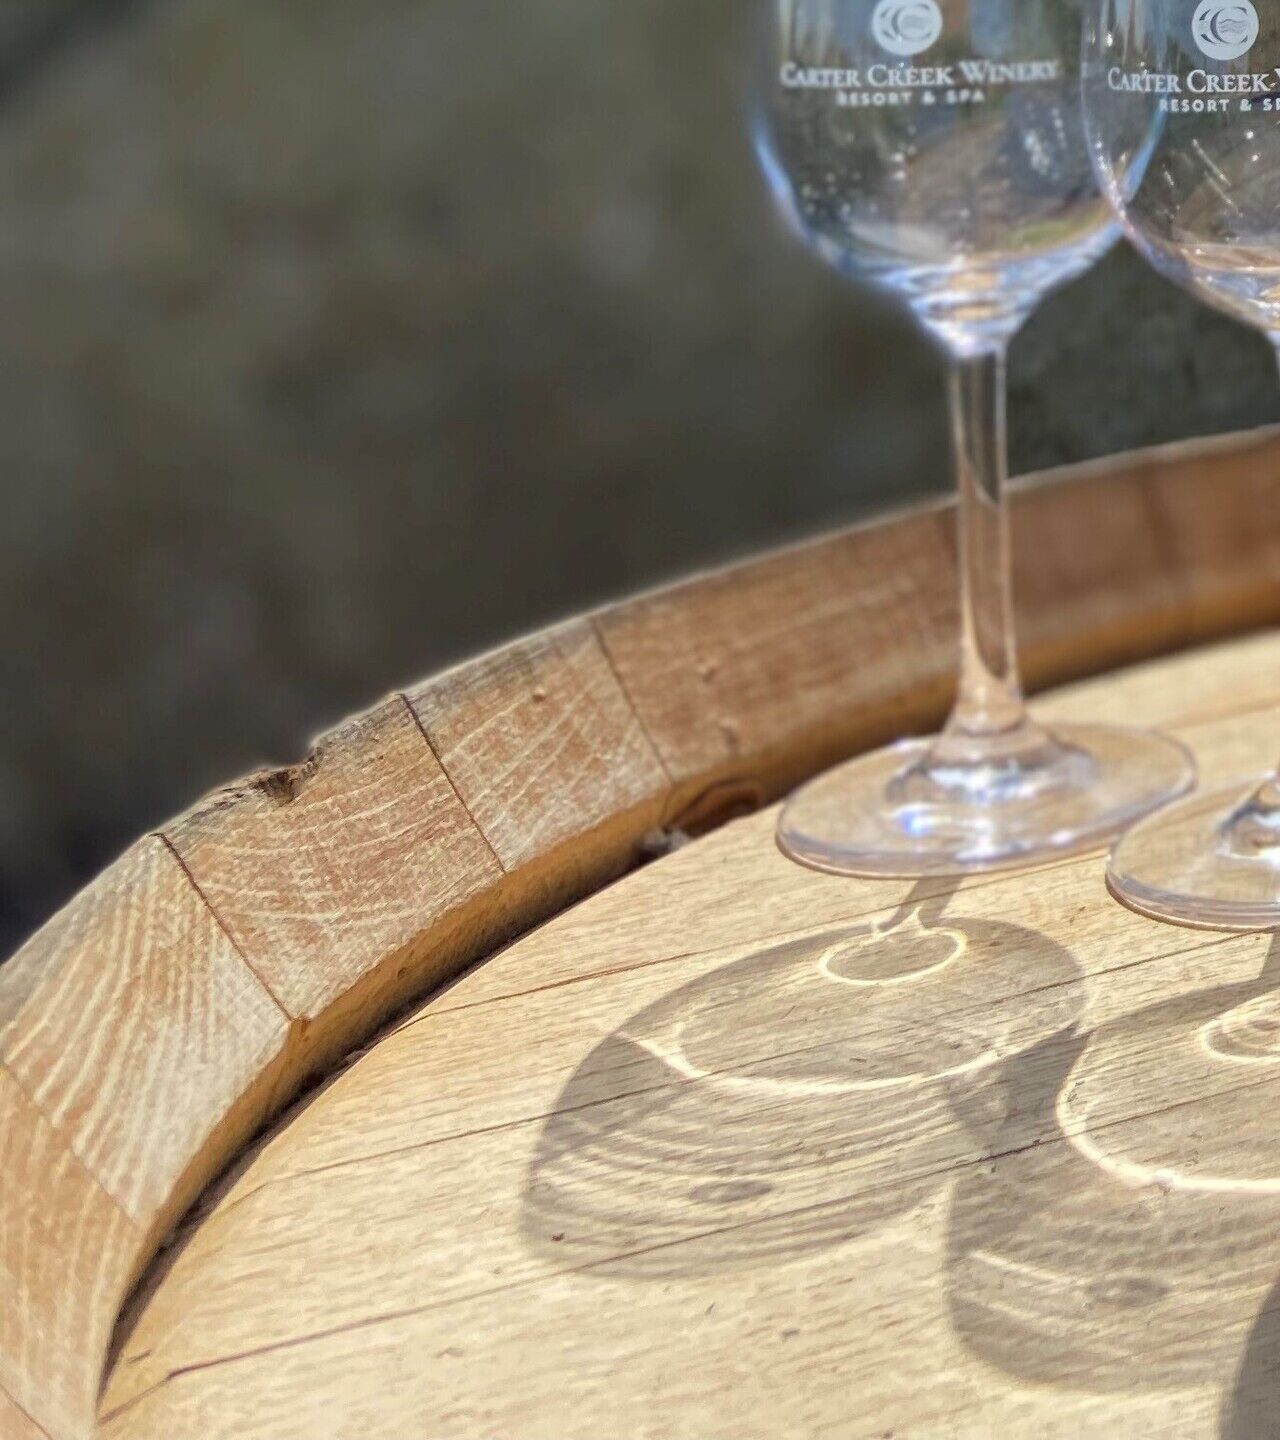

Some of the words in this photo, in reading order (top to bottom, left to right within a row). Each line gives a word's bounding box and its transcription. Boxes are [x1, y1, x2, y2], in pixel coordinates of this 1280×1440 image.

[779, 61, 862, 88] CARTER
[867, 63, 954, 87] CREEK
[959, 59, 1058, 83] WINERY
[1107, 67, 1182, 94] CARTER
[1186, 69, 1271, 94] CREEK
[836, 90, 912, 107] RESORT
[923, 91, 936, 107] &
[947, 89, 985, 105] SPA
[1159, 98, 1230, 113] RESORT
[1239, 98, 1253, 112] &
